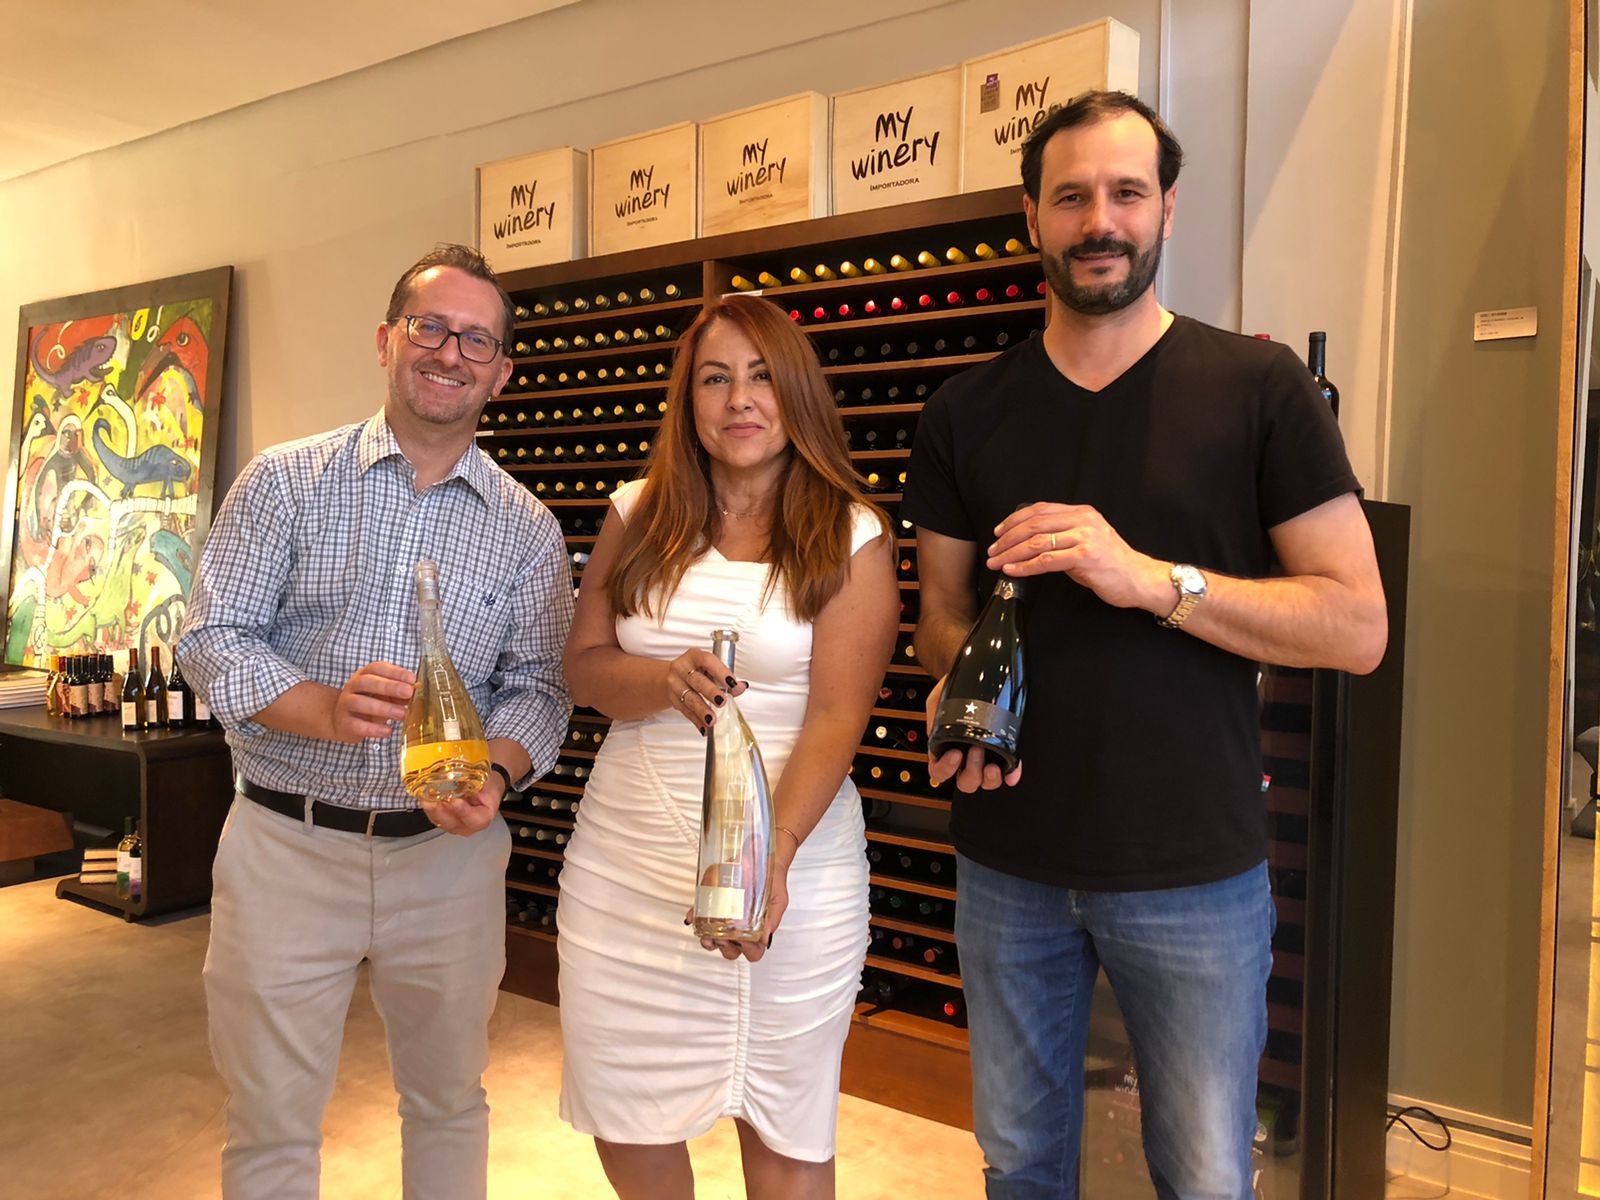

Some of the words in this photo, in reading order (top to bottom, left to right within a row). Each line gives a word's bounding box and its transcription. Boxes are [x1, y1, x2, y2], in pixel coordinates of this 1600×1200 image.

[851, 131, 940, 181] winery
[726, 157, 787, 196] winery
[615, 183, 671, 218] winery
[493, 202, 555, 240] winery
